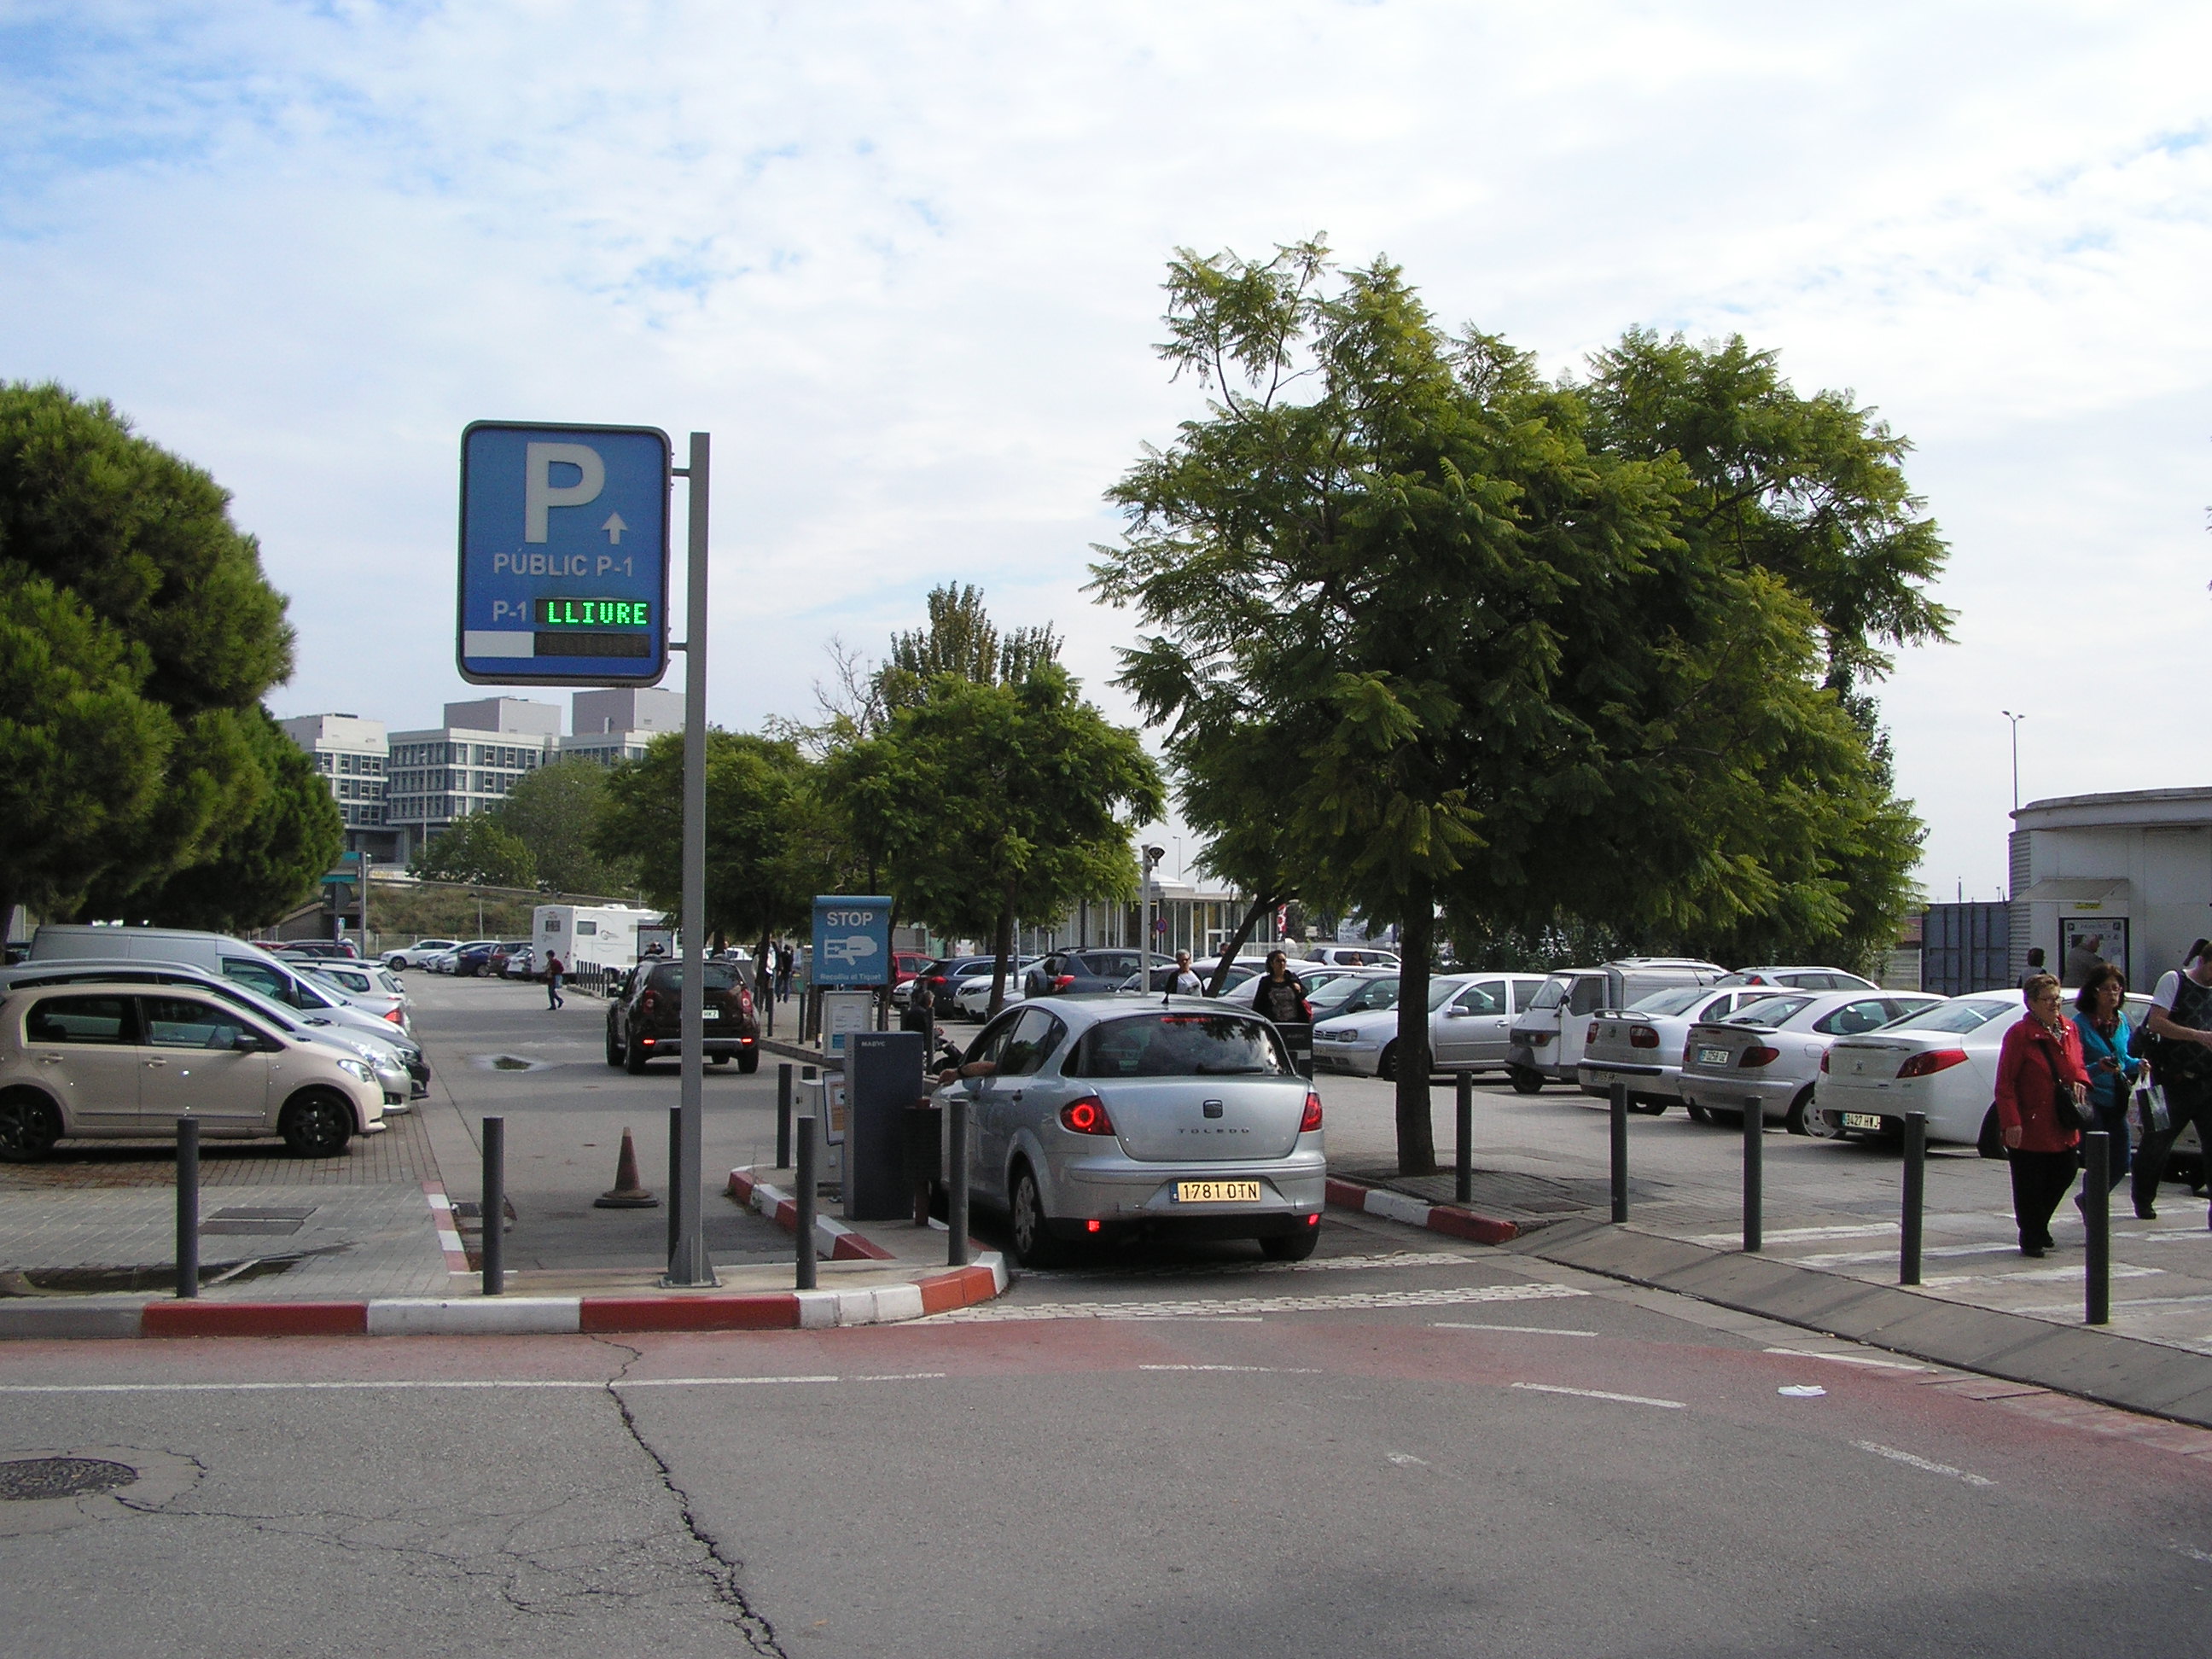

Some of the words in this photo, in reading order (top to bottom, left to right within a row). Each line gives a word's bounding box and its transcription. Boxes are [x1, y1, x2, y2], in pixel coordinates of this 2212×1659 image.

[525, 441, 605, 544] P
[493, 548, 587, 576] PÚBLIC
[597, 555, 633, 577] P-1
[492, 600, 527, 622] P-1
[548, 602, 648, 625] LLIURE
[826, 911, 874, 927] STOP
[1184, 1183, 1221, 1200] 1781
